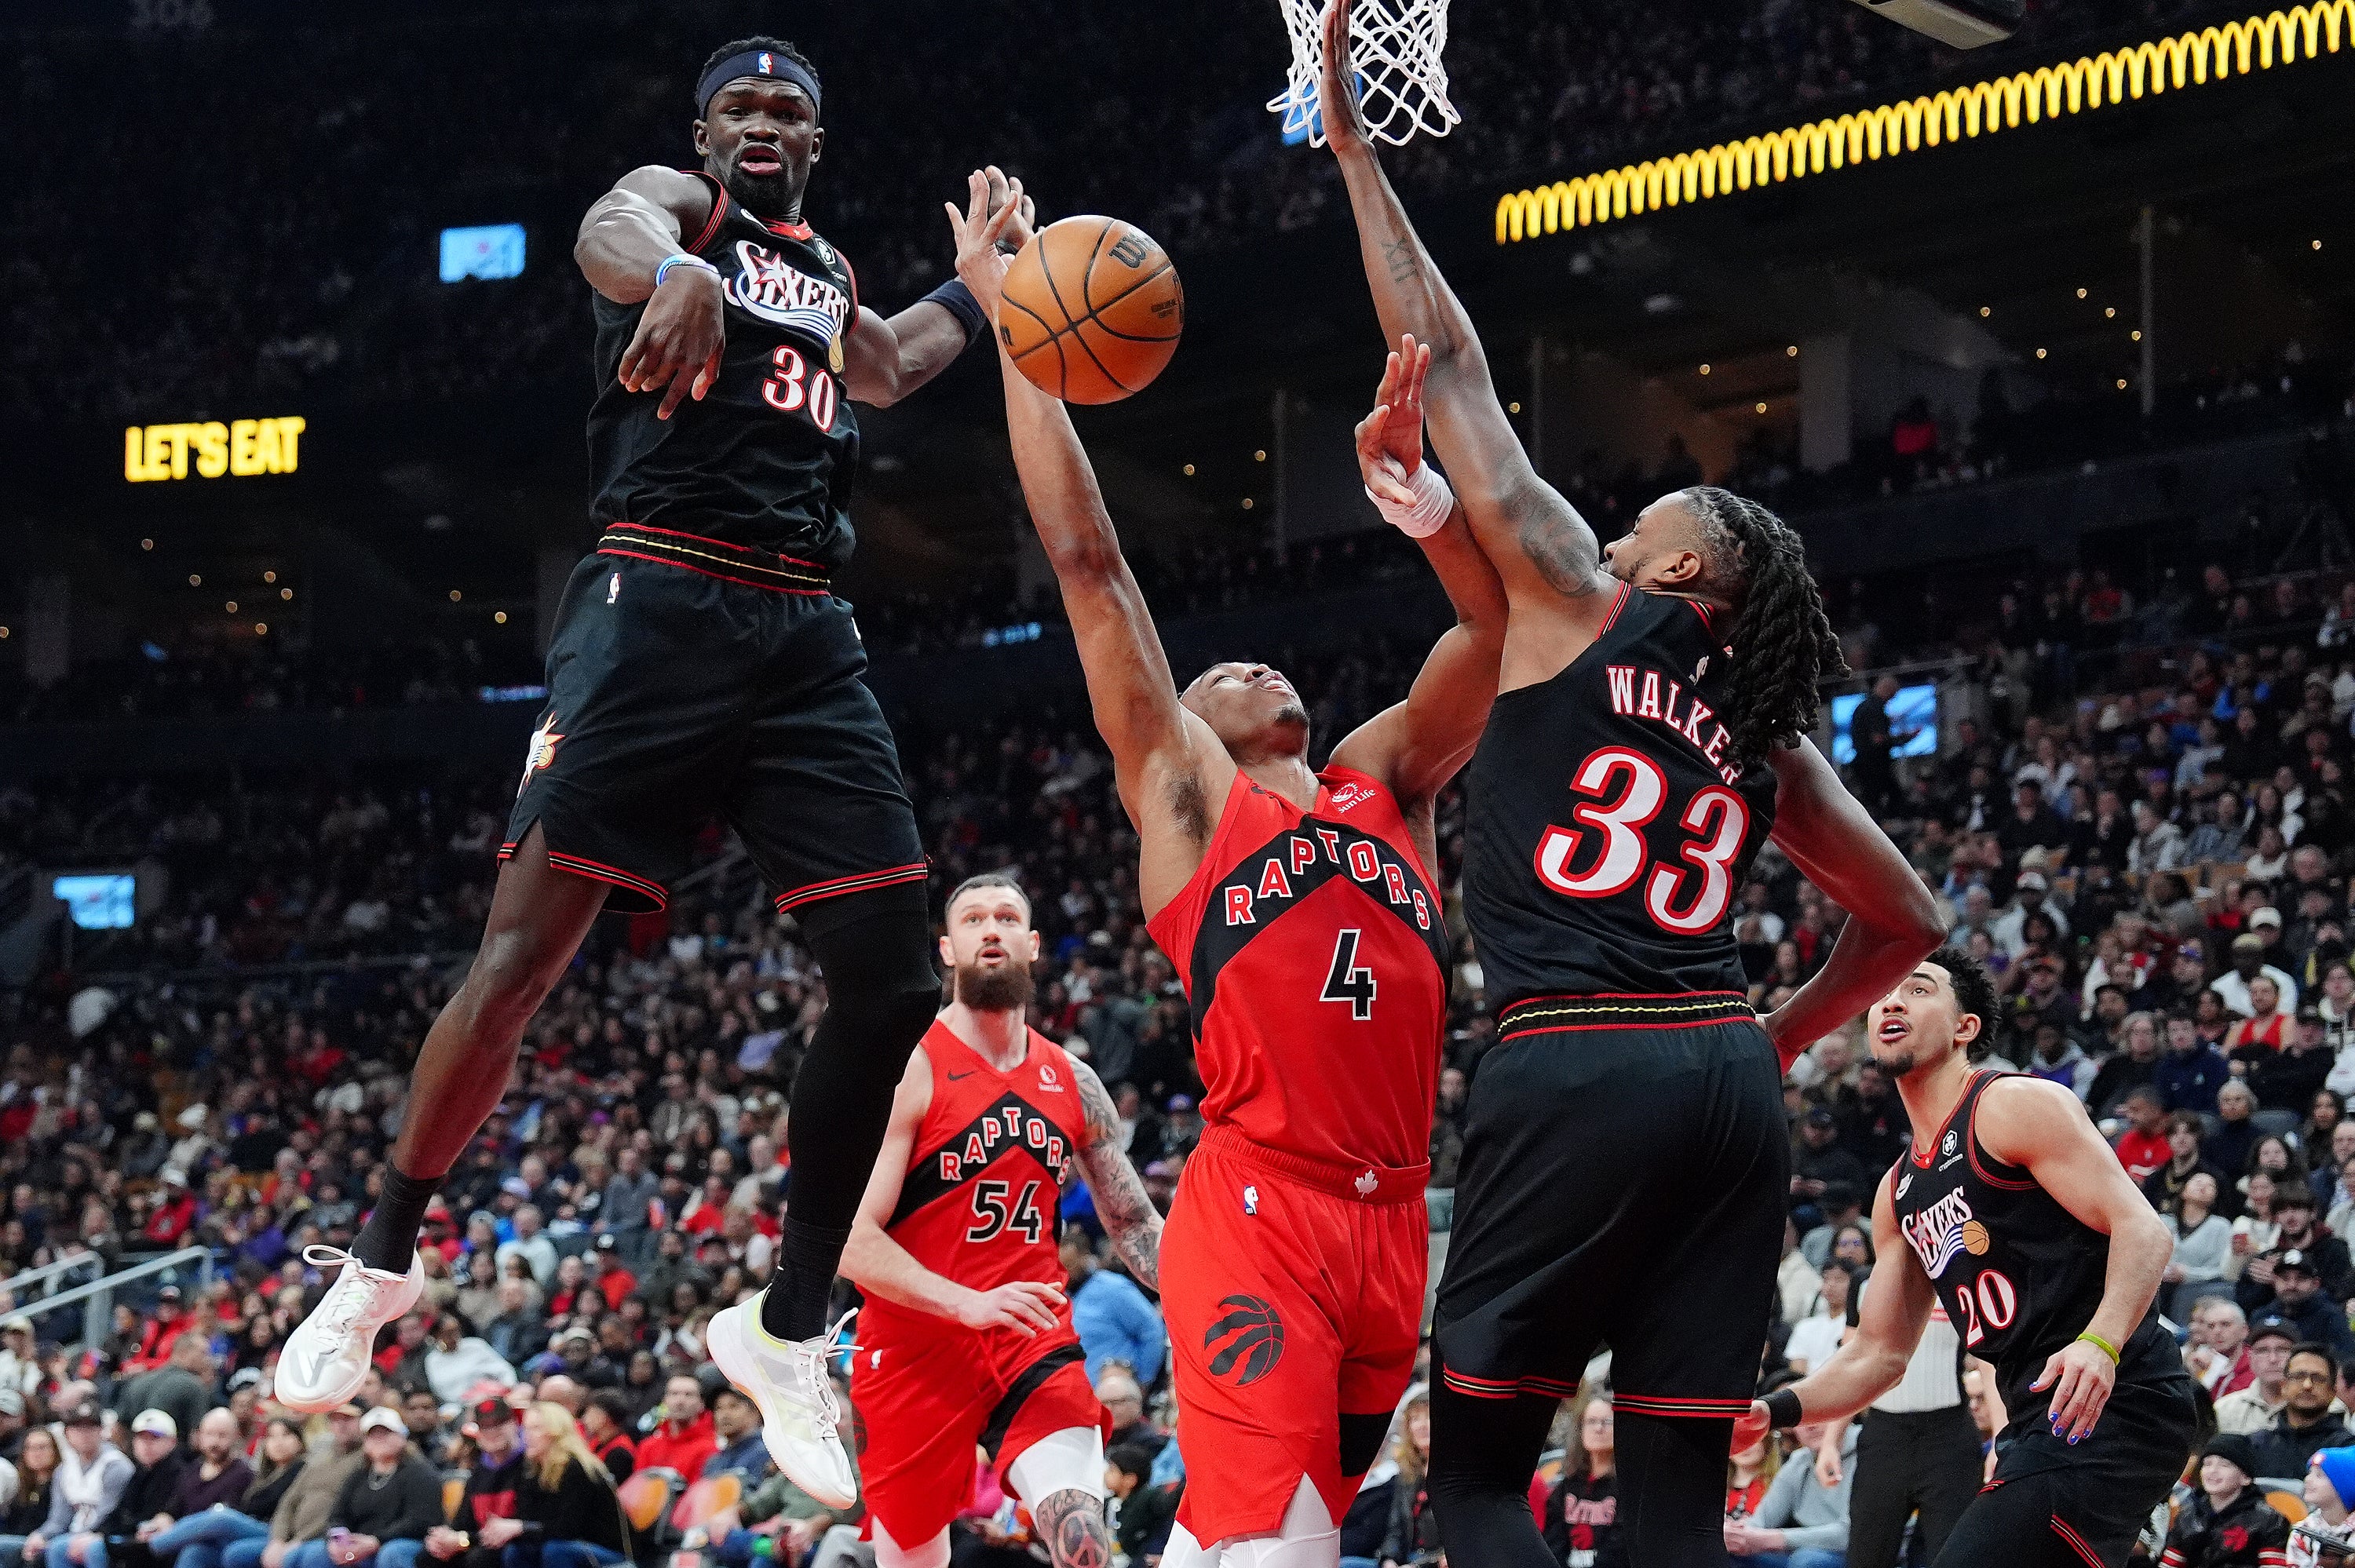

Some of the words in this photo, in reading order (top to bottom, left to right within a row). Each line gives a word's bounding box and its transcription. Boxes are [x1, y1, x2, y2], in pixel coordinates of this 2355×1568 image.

[761, 345, 837, 432] 30
[125, 421, 228, 482] LET'S
[231, 416, 306, 476] EAT
[1356, 788, 1376, 802] Life
[1225, 827, 1430, 930] RAPTORS
[1534, 746, 1750, 935] 33
[1319, 928, 1377, 1021] 4
[940, 1107, 1071, 1184] RAPTORS
[966, 1180, 1042, 1243] 54
[1957, 1269, 2017, 1347] 20
